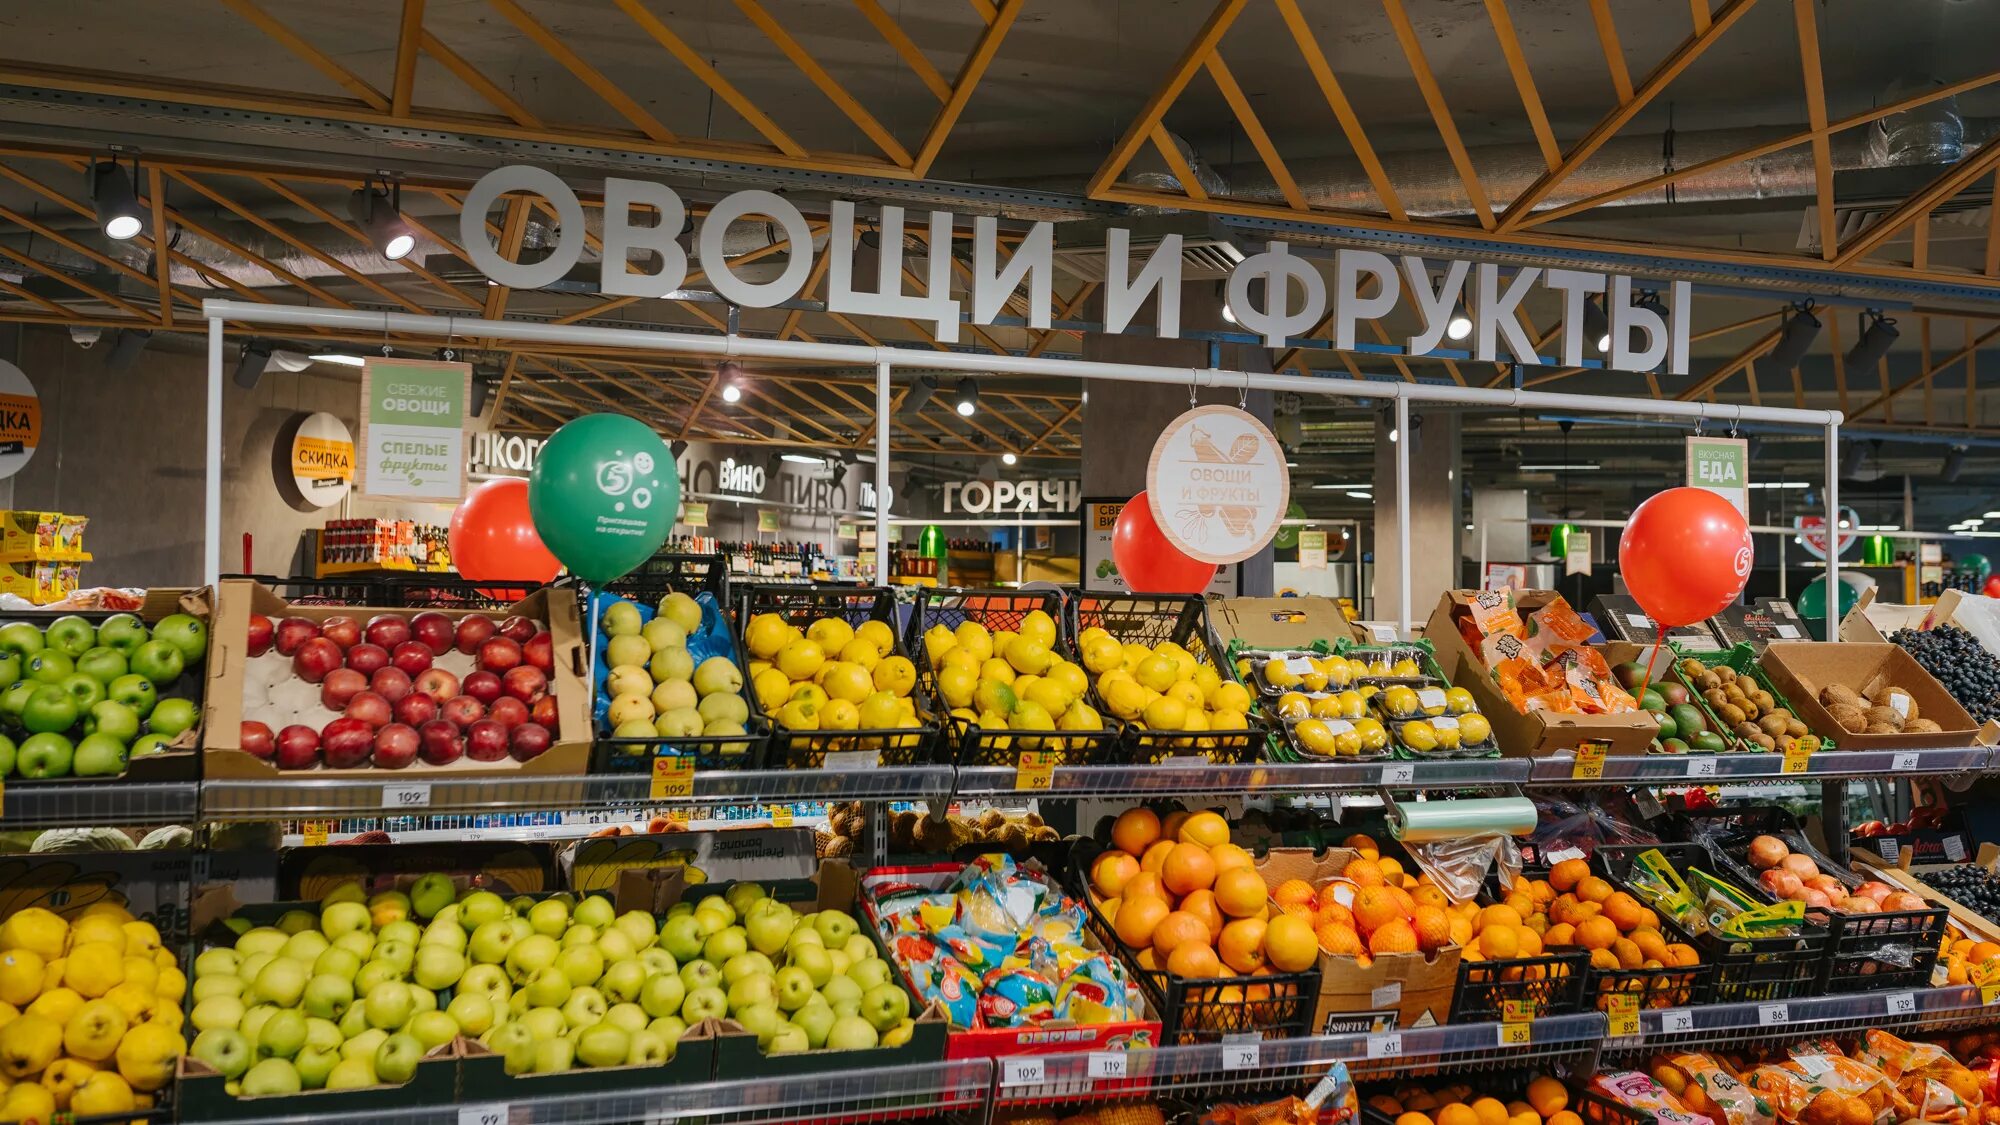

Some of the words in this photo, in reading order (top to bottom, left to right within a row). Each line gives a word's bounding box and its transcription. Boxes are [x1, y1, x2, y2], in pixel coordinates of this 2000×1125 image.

[460, 165, 1054, 343] ОВОЩИ
[1105, 227, 1183, 339] И
[1224, 241, 1692, 375] ФРУКТЫ
[387, 383, 448, 398] СВЕЖИЕ
[381, 398, 451, 415] ОВОЩИ
[380, 441, 449, 457] СПЕЛЫЕ
[472, 432, 549, 471] ЛКОГ
[1698, 449, 1736, 460] ВКУСНАЯ
[298, 449, 349, 469] СКИДКА
[379, 457, 449, 476] фрукты
[1699, 460, 1737, 483] ЕДА
[1189, 468, 1252, 484] ОВОЩИ
[1181, 487, 1193, 500] И
[1196, 487, 1260, 502] ФРУКТЫ
[1099, 505, 1124, 516] СВЕ
[1099, 516, 1118, 527] ВИ
[1583, 767, 1598, 775] 109
[1701, 764, 1711, 772] 25
[1396, 771, 1408, 779] 79
[1033, 777, 1047, 787] 99
[664, 784, 686, 794] 109
[398, 792, 421, 802] 109
[712, 838, 763, 852] bananas
[734, 847, 785, 862] Premium
[1896, 1000, 1910, 1009] 129
[1772, 1010, 1783, 1020] 86
[1331, 1021, 1371, 1034] SOFIYA
[1623, 1022, 1635, 1031] 89
[1677, 1018, 1688, 1026] 79
[1512, 1030, 1525, 1041] 56
[1384, 1041, 1396, 1052] 61
[1240, 1053, 1253, 1064] 79
[1103, 1061, 1120, 1072] 119
[1017, 1067, 1037, 1079] 109
